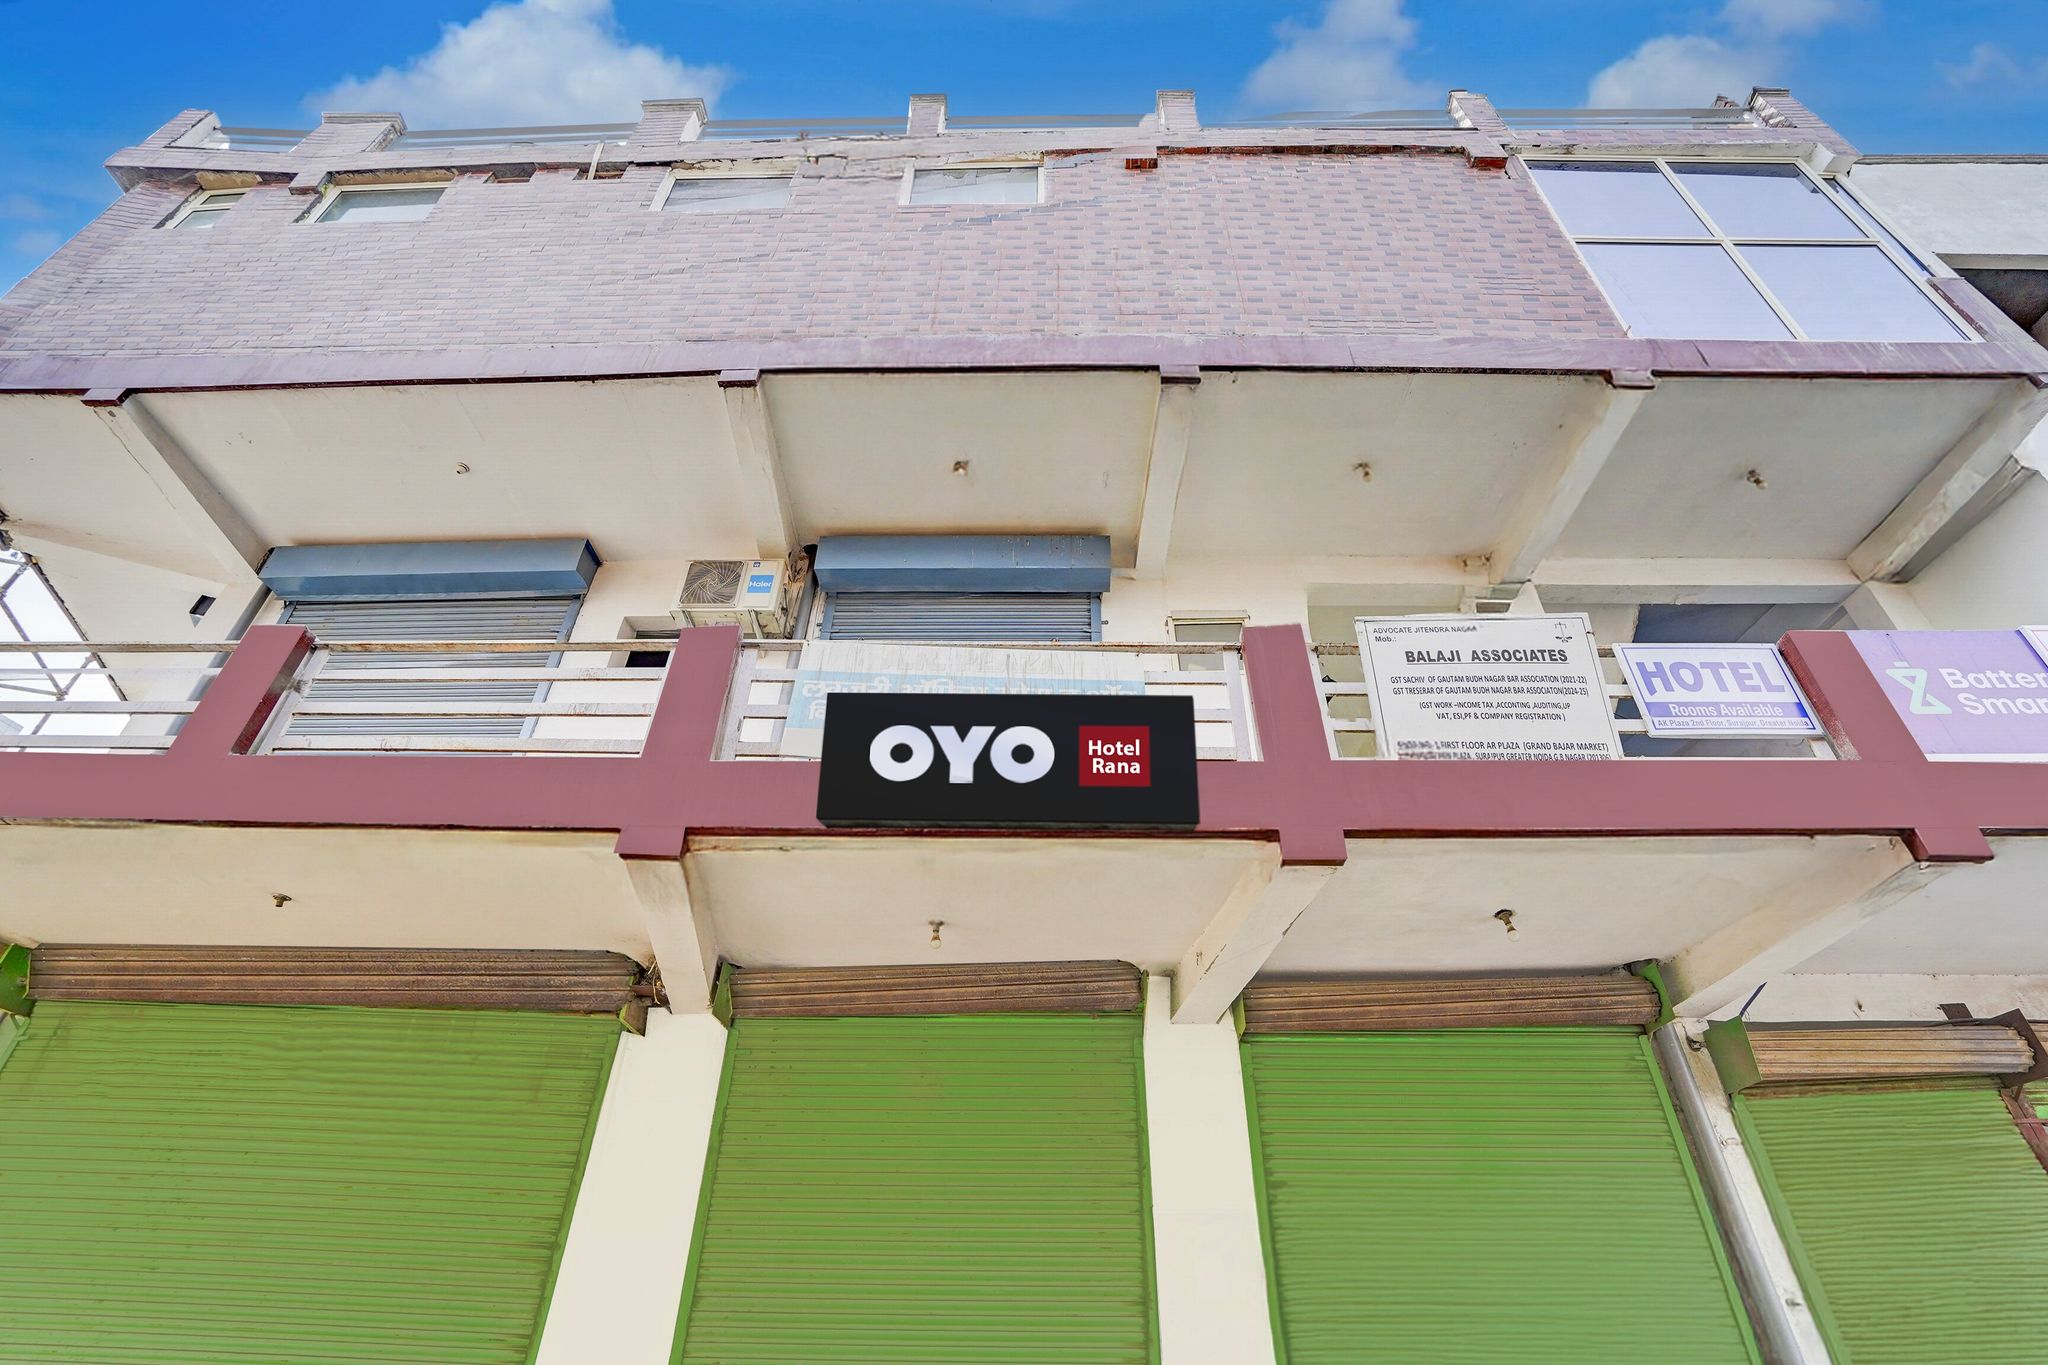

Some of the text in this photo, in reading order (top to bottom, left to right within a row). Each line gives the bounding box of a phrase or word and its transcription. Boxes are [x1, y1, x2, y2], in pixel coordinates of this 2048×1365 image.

[1373, 626, 1412, 634] ADVOCATE
[1414, 626, 1450, 634] JITENDRA
[1405, 649, 1568, 662] BALAJI ASSOCIATES
[1390, 676, 1402, 684] GST
[1403, 676, 1425, 684] SACHIV
[1437, 675, 1464, 683] GAUTAM
[1520, 675, 1559, 683] ASSOCIATION
[1560, 675, 1588, 684] (2021-22)
[1636, 661, 1785, 696] HOTEL
[1392, 687, 1404, 695] GST
[1668, 704, 1784, 716] Rooms Available
[1088, 739, 1140, 756] Hotel
[1440, 741, 1460, 750] FIRST
[1462, 741, 1484, 750] FLOOR
[1486, 741, 1497, 750] AR
[1498, 742, 1520, 750] PLAZA
[1522, 742, 1552, 751] (GRAND
[1553, 742, 1576, 750] BAJAR
[1576, 742, 1610, 752] MARKET)
[869, 724, 1056, 784] OYO
[1092, 758, 1141, 774] Rana
